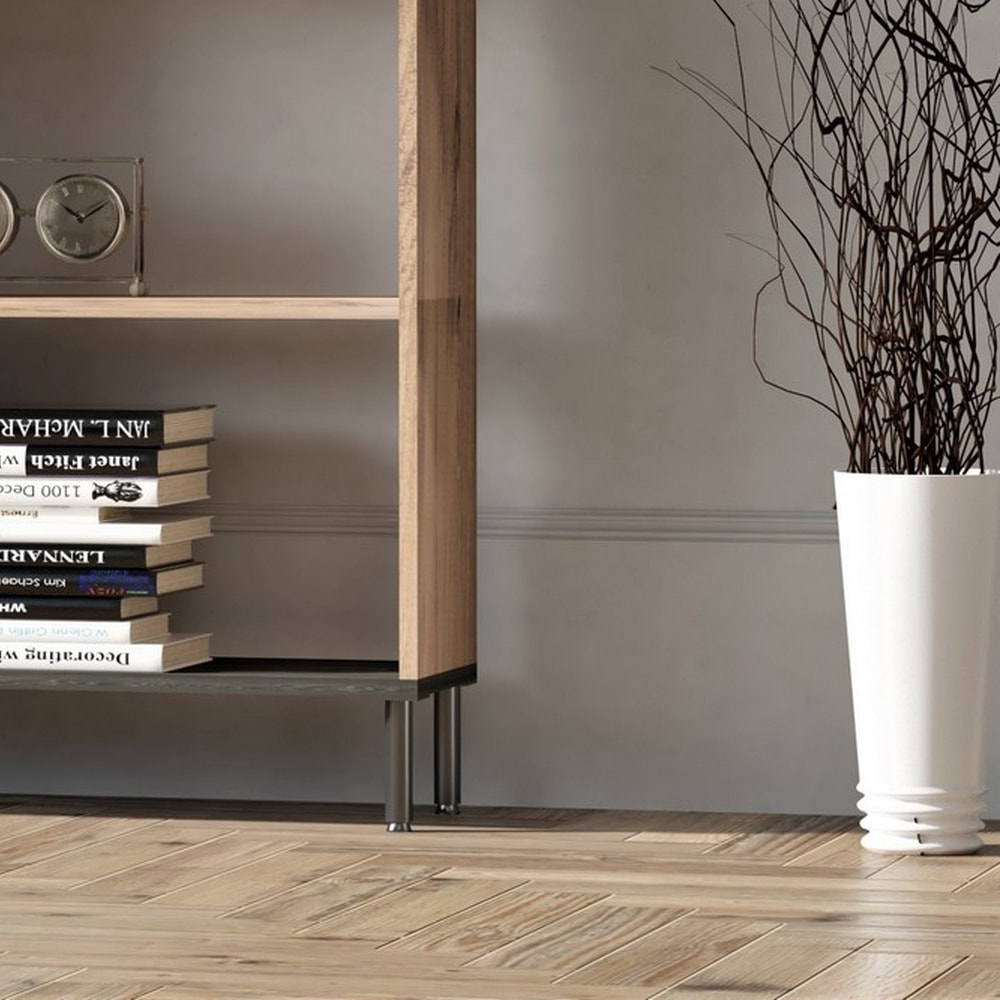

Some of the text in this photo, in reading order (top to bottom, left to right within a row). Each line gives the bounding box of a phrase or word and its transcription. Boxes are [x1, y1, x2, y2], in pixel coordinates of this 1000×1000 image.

[90, 419, 110, 438] L.
[31, 454, 140, 470] Janet Fitch
[40, 484, 82, 498] 1100
[0, 509, 39, 518] Ernest
[44, 577, 67, 587] Kim
[8, 626, 48, 637] Griffin
[24, 647, 131, 666] Decorating
